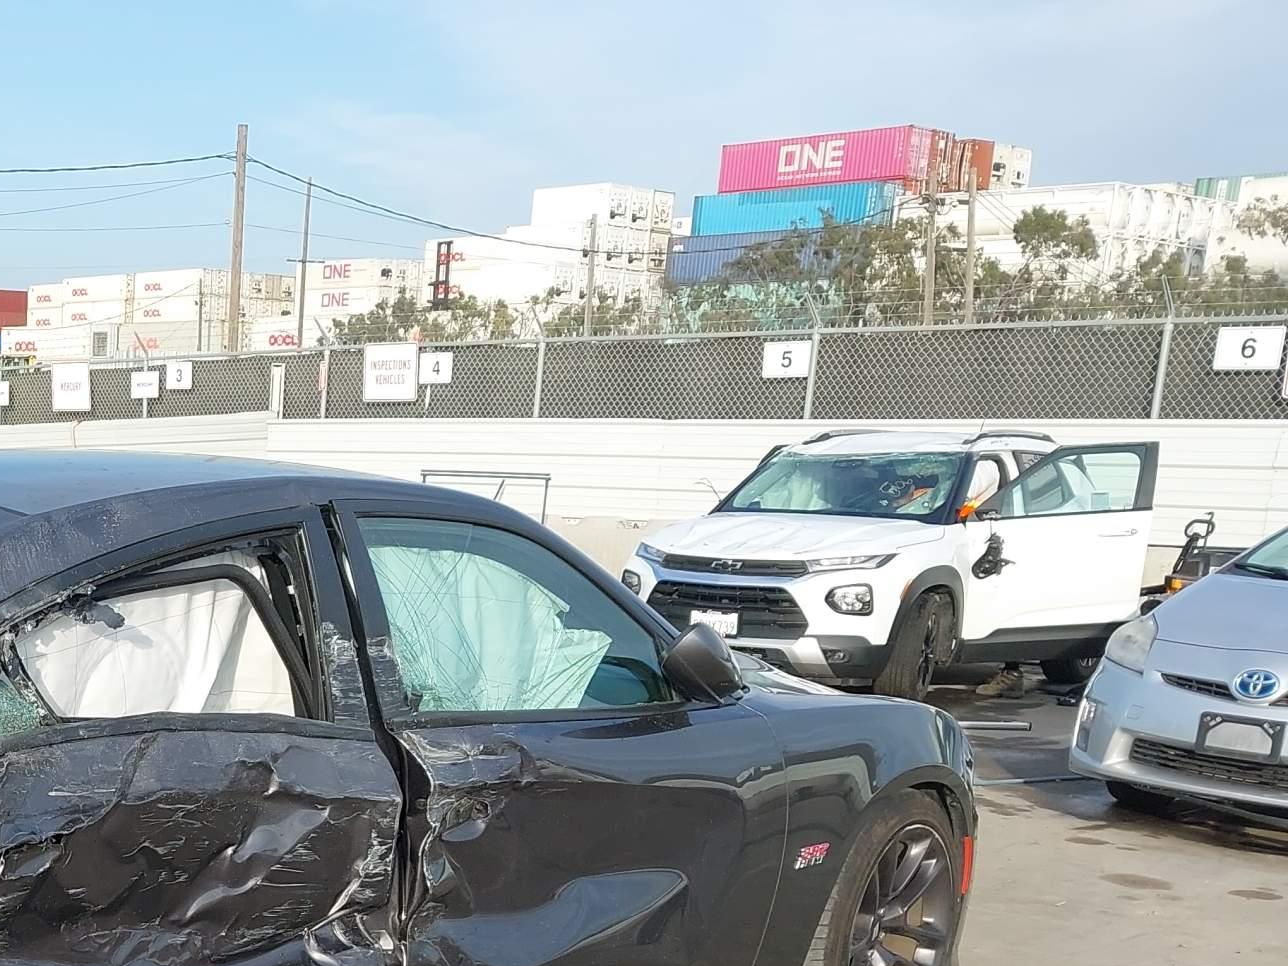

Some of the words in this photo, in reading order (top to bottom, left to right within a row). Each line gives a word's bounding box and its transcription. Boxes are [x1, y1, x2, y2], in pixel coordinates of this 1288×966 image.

[778, 140, 845, 172] ONE
[323, 264, 351, 279] ONE
[321, 292, 350, 307] ONE
[15, 341, 37, 352] OOCL
[269, 334, 299, 346] OOCL
[1241, 338, 1257, 359] 6
[781, 350, 792, 368] 5
[432, 361, 440, 375] 4
[176, 369, 183, 383] 3
